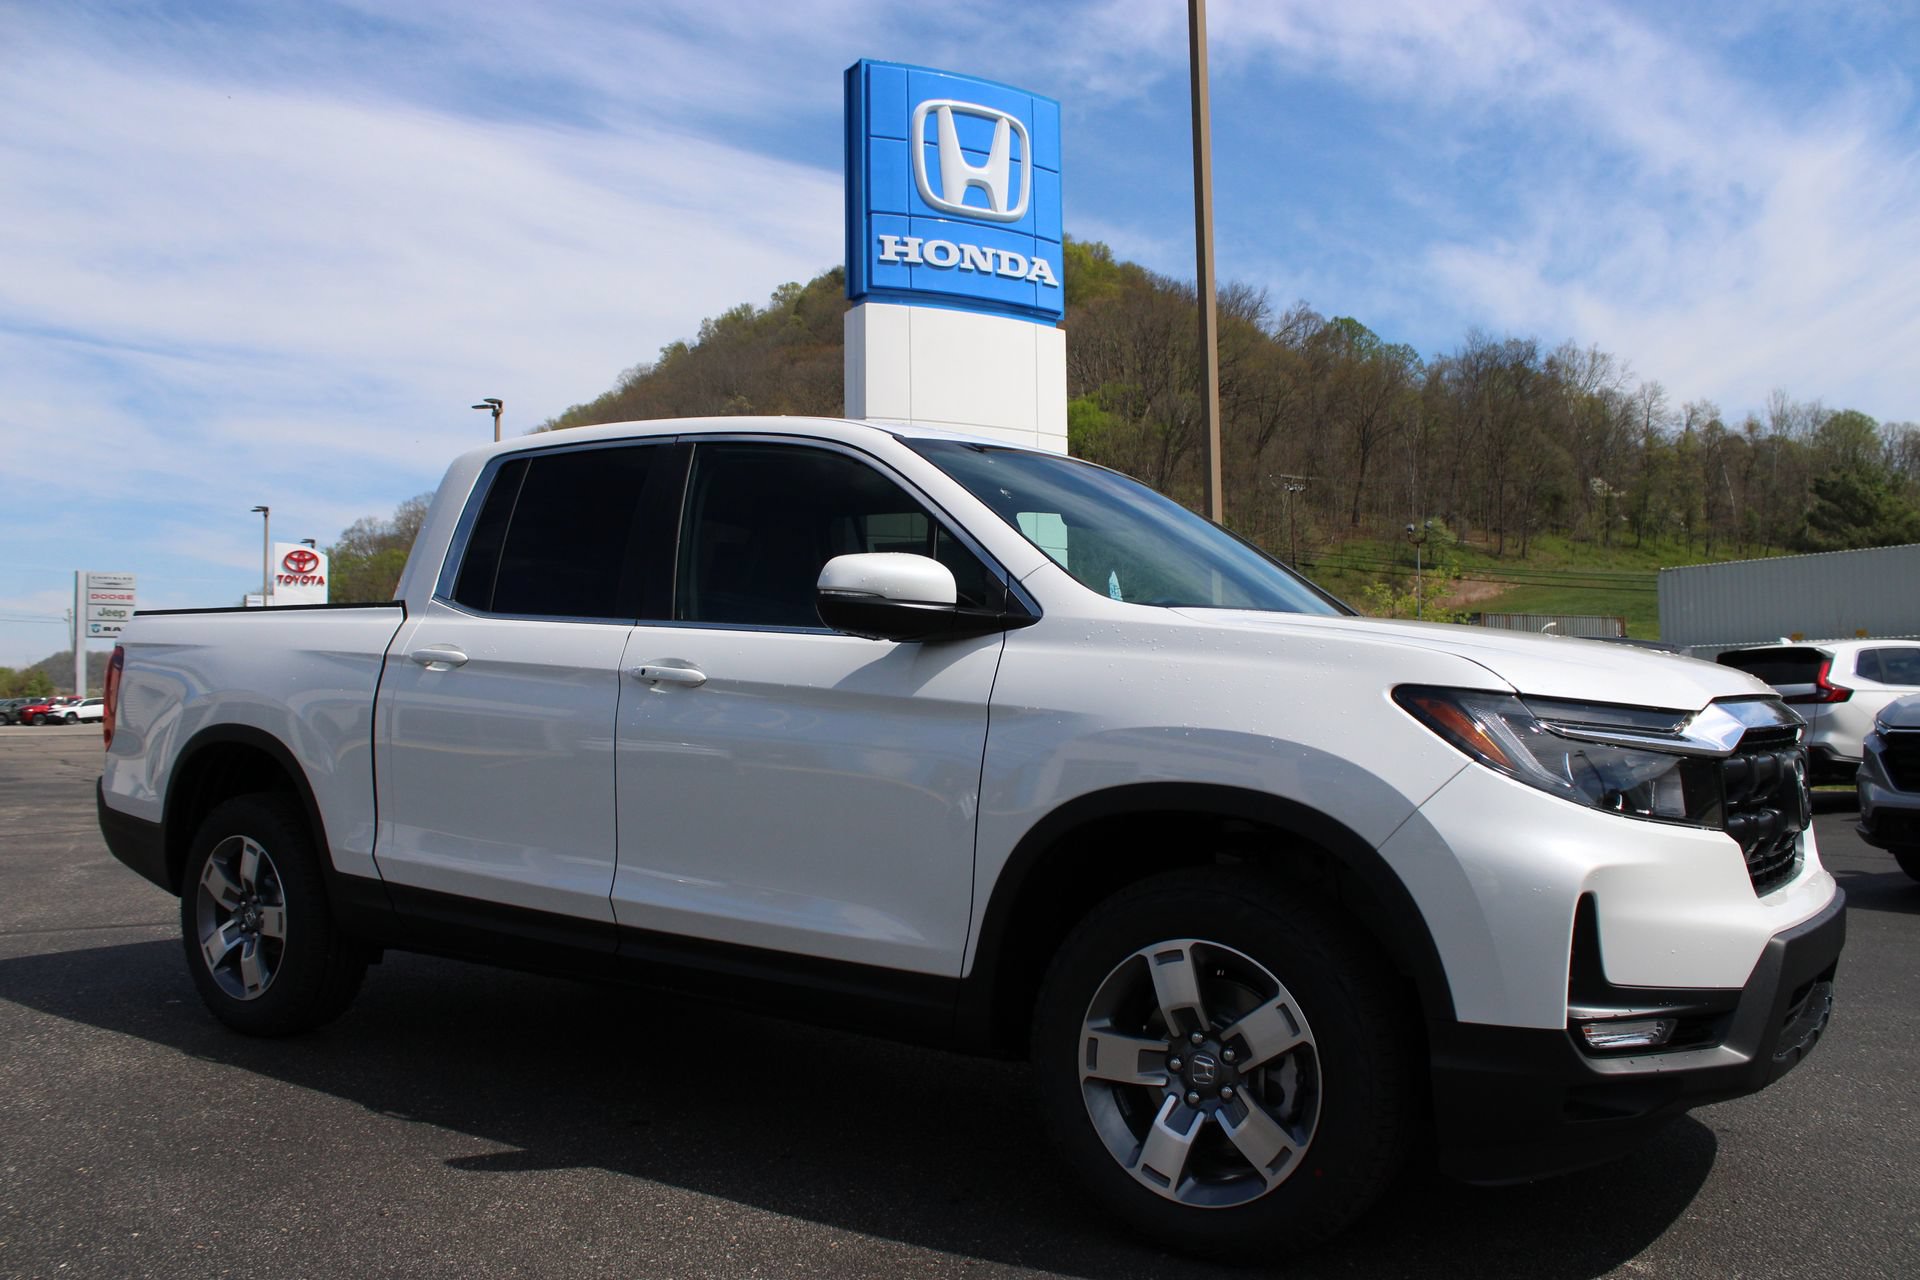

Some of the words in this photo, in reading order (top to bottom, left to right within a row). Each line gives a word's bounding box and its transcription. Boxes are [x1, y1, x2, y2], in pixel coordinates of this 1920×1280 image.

[879, 234, 1059, 287] HONDA
[277, 574, 325, 586] TOYOTA
[97, 607, 126, 619] Jeep
